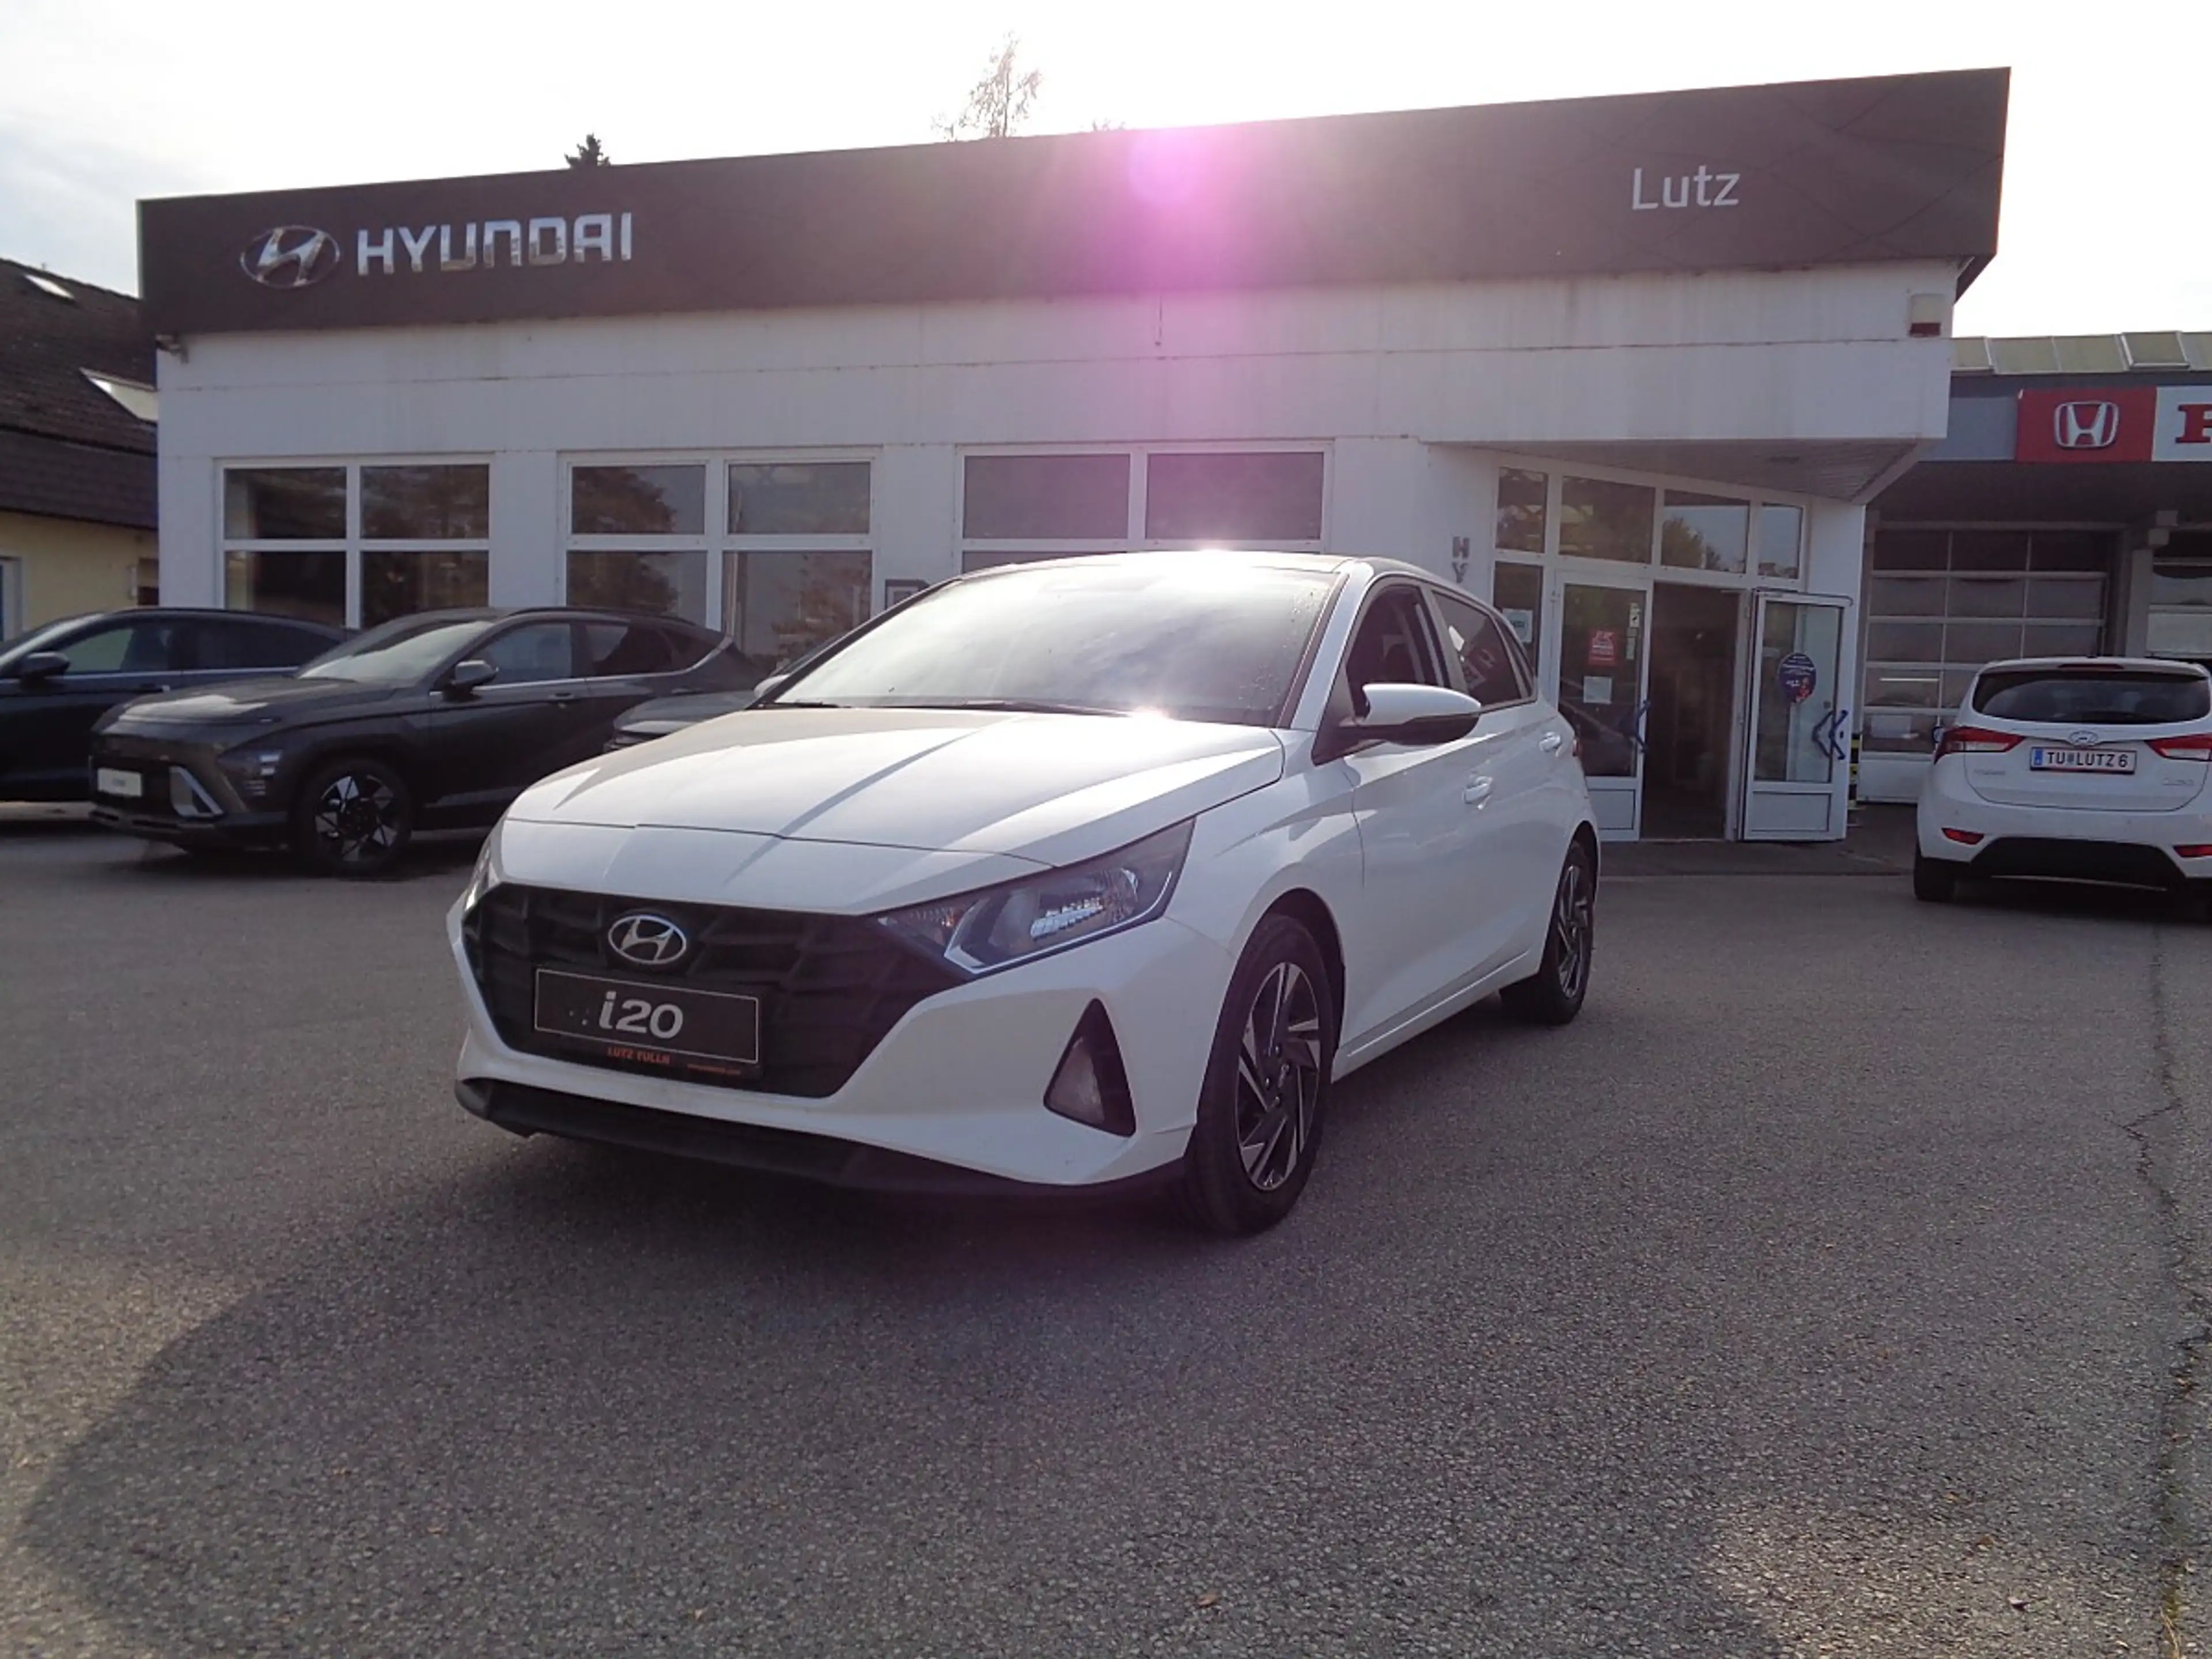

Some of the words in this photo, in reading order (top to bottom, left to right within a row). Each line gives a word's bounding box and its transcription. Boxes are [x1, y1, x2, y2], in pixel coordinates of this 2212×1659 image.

[1632, 165, 1740, 210] Lutz
[357, 212, 632, 276] HYUNDAI
[2047, 751, 2066, 764] TU
[2076, 752, 2115, 768] LUTZ
[2118, 753, 2128, 768] 6
[599, 991, 683, 1039] i20
